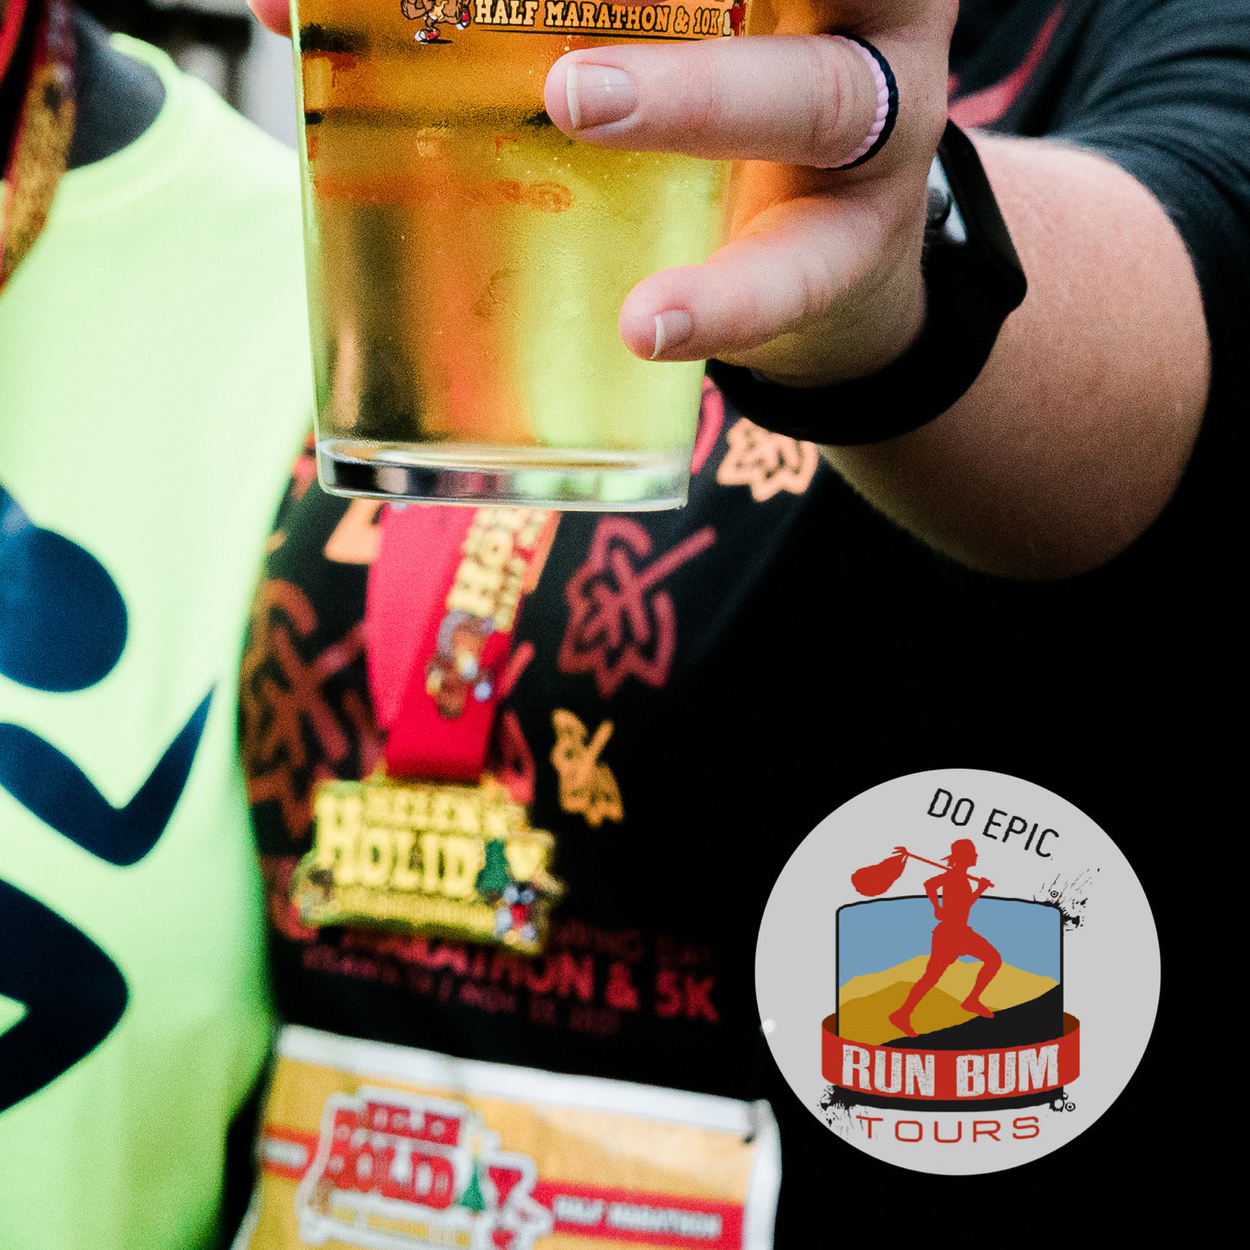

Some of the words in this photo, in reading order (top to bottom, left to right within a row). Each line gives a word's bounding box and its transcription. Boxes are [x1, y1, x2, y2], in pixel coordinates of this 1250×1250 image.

[673, 6, 689, 35] &
[693, 6, 721, 36] 10K
[655, 969, 720, 1024] 5K
